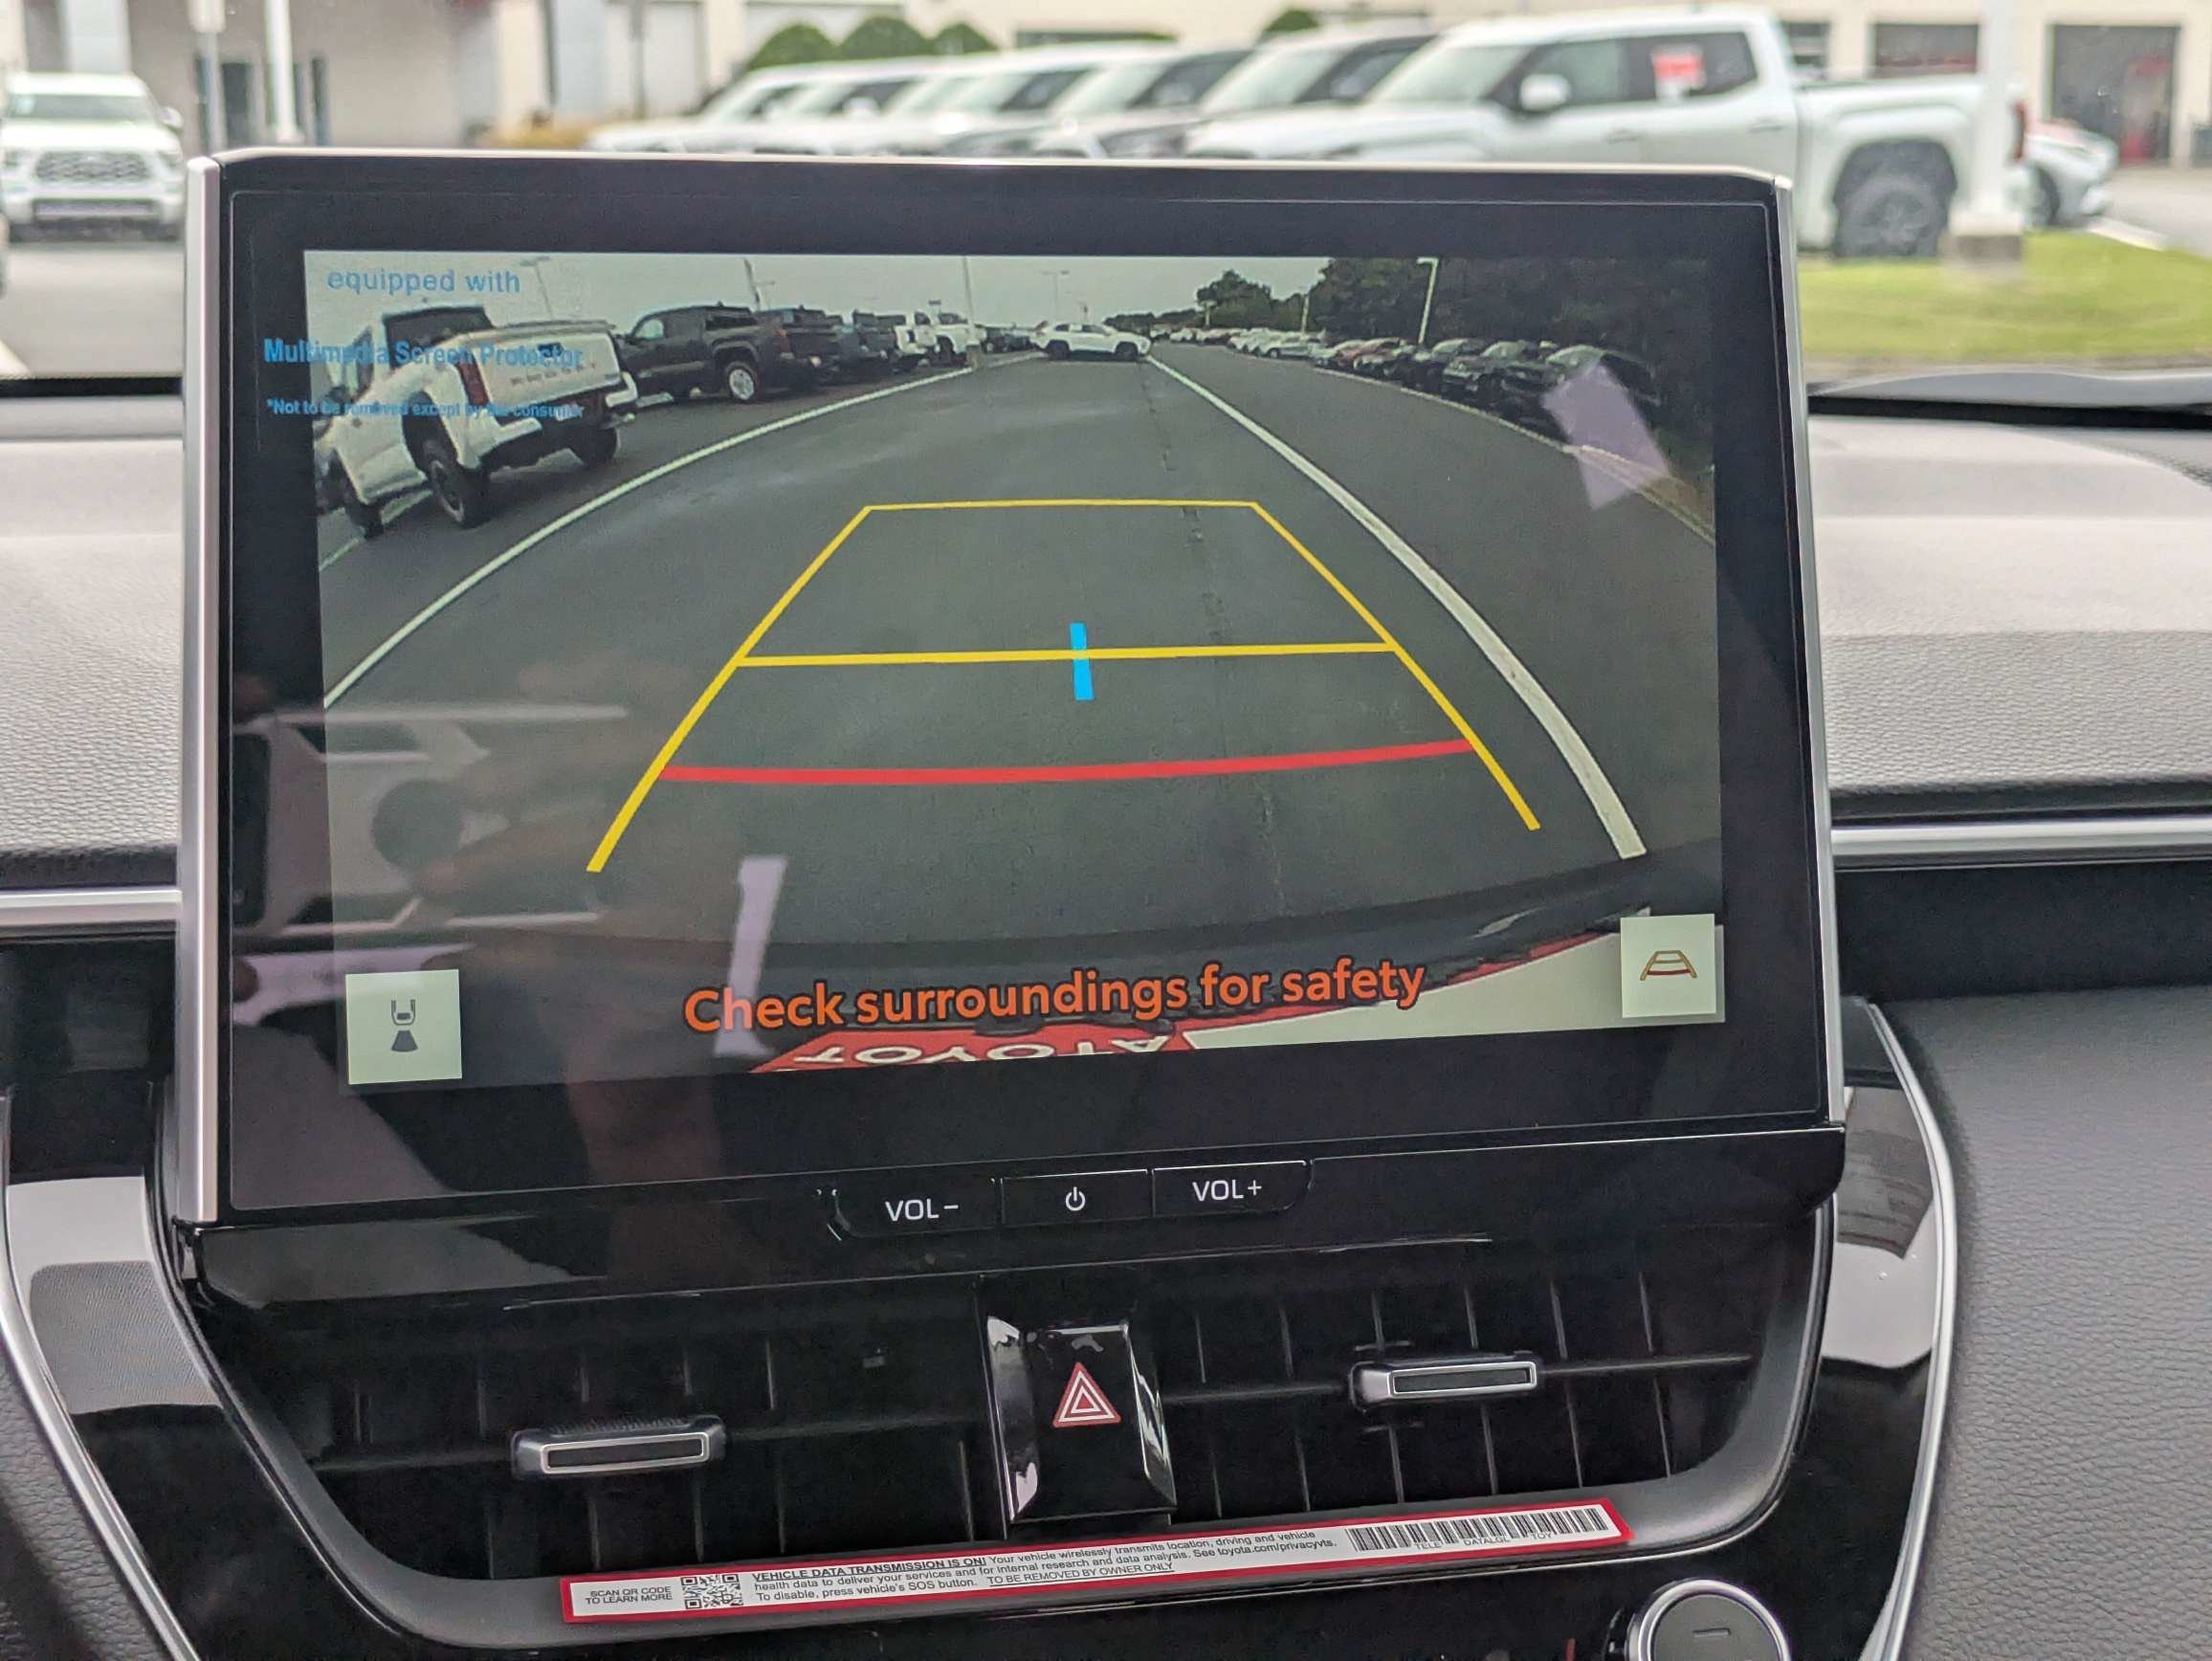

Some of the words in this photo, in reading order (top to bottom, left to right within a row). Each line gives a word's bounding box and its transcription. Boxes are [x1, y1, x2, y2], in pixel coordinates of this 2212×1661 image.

[327, 269, 454, 296] equipped
[465, 270, 520, 293] with
[394, 340, 476, 365] Screen
[480, 342, 582, 366] Protector
[302, 398, 318, 414] to
[683, 982, 845, 1033] Check
[855, 969, 1189, 1020] surroundings
[1200, 963, 1270, 1007] for
[1282, 957, 1426, 1011] safety
[752, 1570, 808, 1581] VEHICLE
[811, 1567, 847, 1579] DATA
[850, 1560, 944, 1575] TRANSMISSION
[948, 1558, 961, 1569] IS
[988, 1555, 1014, 1564] Your
[1017, 1550, 1056, 1562] vehicle
[1059, 1547, 1112, 1560] wirelessly
[1115, 1542, 1165, 1555] transmits
[1167, 1538, 1214, 1550] location,
[1216, 1536, 1252, 1546] driving
[1255, 1534, 1274, 1543] and
[1277, 1531, 1316, 1541] vehicle
[755, 1580, 790, 1591] health
[793, 1578, 819, 1588] data
[822, 1577, 833, 1586] to
[837, 1575, 874, 1585] deliver
[876, 1574, 902, 1584] your
[905, 1569, 953, 1581] services
[956, 1566, 977, 1577] and
[979, 1565, 995, 1576] for
[997, 1563, 1039, 1574] internal
[1041, 1559, 1090, 1571] research
[1093, 1556, 1114, 1566] and
[1116, 1554, 1140, 1564] data
[1194, 1547, 1216, 1558] See
[590, 1589, 620, 1598] SCAN
[622, 1588, 639, 1597] QR
[641, 1585, 672, 1595] CODE
[757, 1591, 771, 1602] To
[773, 1589, 820, 1601] disable,
[823, 1587, 854, 1600] press
[856, 1582, 906, 1594] vehicle's
[908, 1580, 936, 1591] SOS
[938, 1578, 978, 1589] button.
[987, 1576, 1004, 1585] TO
[1006, 1574, 1021, 1583] BE
[1024, 1567, 1080, 1582] REMOVED
[1082, 1567, 1096, 1578] BY
[1099, 1564, 1141, 1576] OWNER
[1144, 1561, 1174, 1573] ONLY
[586, 1597, 601, 1606] TO
[603, 1594, 638, 1604] LEARN
[641, 1592, 673, 1602] MORE
